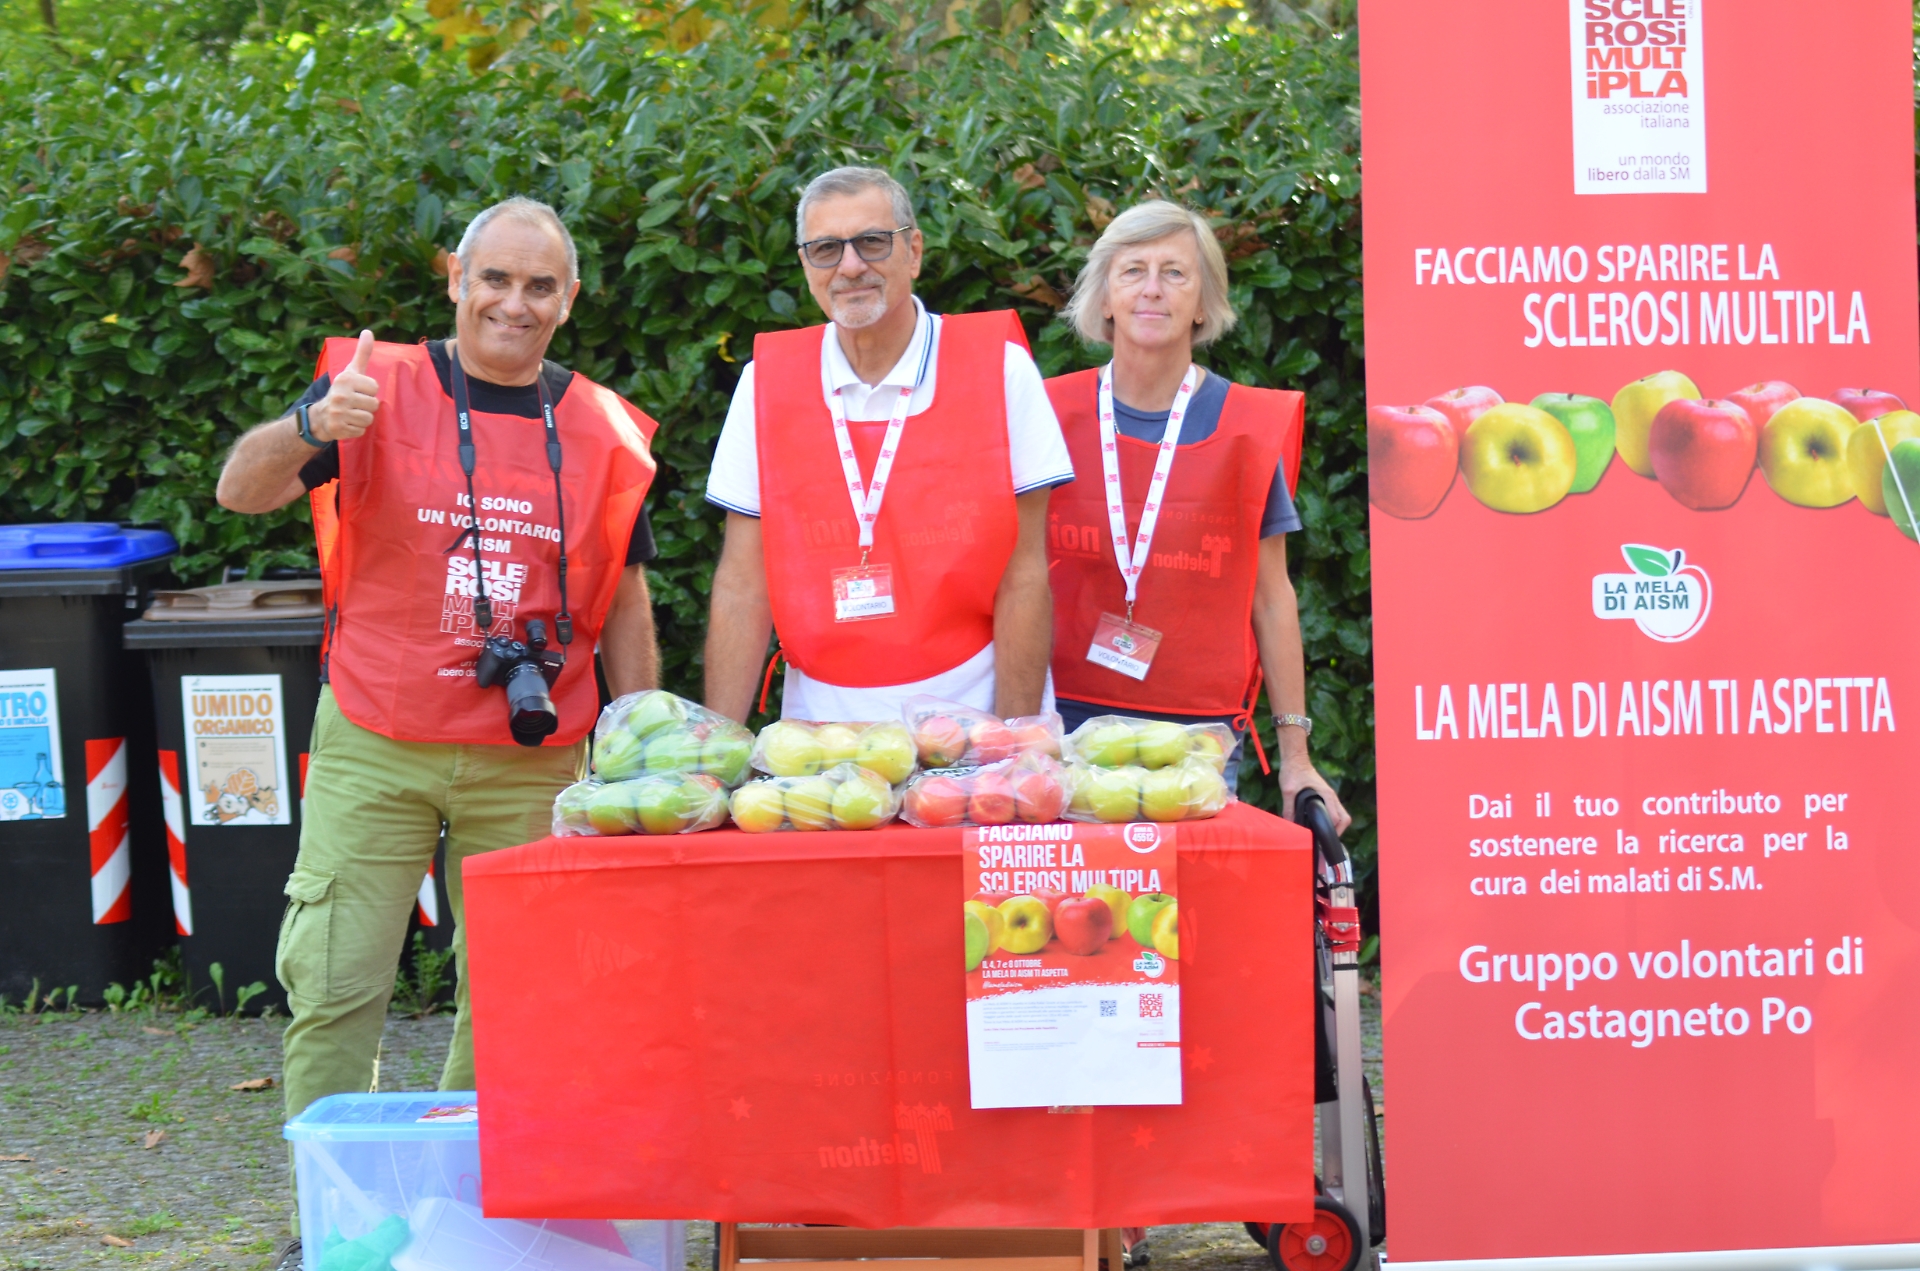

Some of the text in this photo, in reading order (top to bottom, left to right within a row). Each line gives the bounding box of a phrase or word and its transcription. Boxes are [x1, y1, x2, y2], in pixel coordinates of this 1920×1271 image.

[1585, 0, 1685, 20] SCLE
[1586, 47, 1686, 70] MULT
[1603, 101, 1689, 114] associazione
[1641, 115, 1690, 128] italiana
[1618, 152, 1690, 166] un mondo
[1588, 167, 1690, 181] libero dalla SM
[1415, 243, 1780, 285] FACCIAMO SPARIRE LA
[1523, 290, 1870, 348] SCLEROSI MULTIPLA
[456, 493, 533, 514] IO SONO
[417, 508, 562, 543] UN VOLONTARIO
[463, 536, 511, 553] AISM
[447, 556, 523, 583] SCLE
[1604, 581, 1688, 594] LA MELA
[442, 593, 518, 619] MLT
[843, 602, 887, 612] VOLONTARIO
[1604, 594, 1690, 611] DI AISM
[1098, 650, 1139, 671] VOLONTARIO
[437, 667, 465, 677] libero
[192, 693, 273, 717] UMIDO
[1415, 676, 1895, 740] LA MELA DI AISM TI ASPETTA
[193, 718, 274, 735] ORGANICO
[1469, 788, 1848, 818] Dai il tuo contributo per
[979, 824, 1073, 842] FACCIAMO
[1469, 825, 1848, 858] sostenere la ricerca per la
[979, 844, 1085, 868] SPARIRE LA
[979, 868, 1161, 894] SCLEROSI MULTIPLA
[1470, 866, 1763, 895] cura dei malati di S.M.
[982, 970, 991, 978] LA
[1041, 968, 1069, 977] ASPETTA
[1459, 936, 1863, 991] Gruppo volontari di
[1515, 997, 1812, 1048] Castagneto Po
